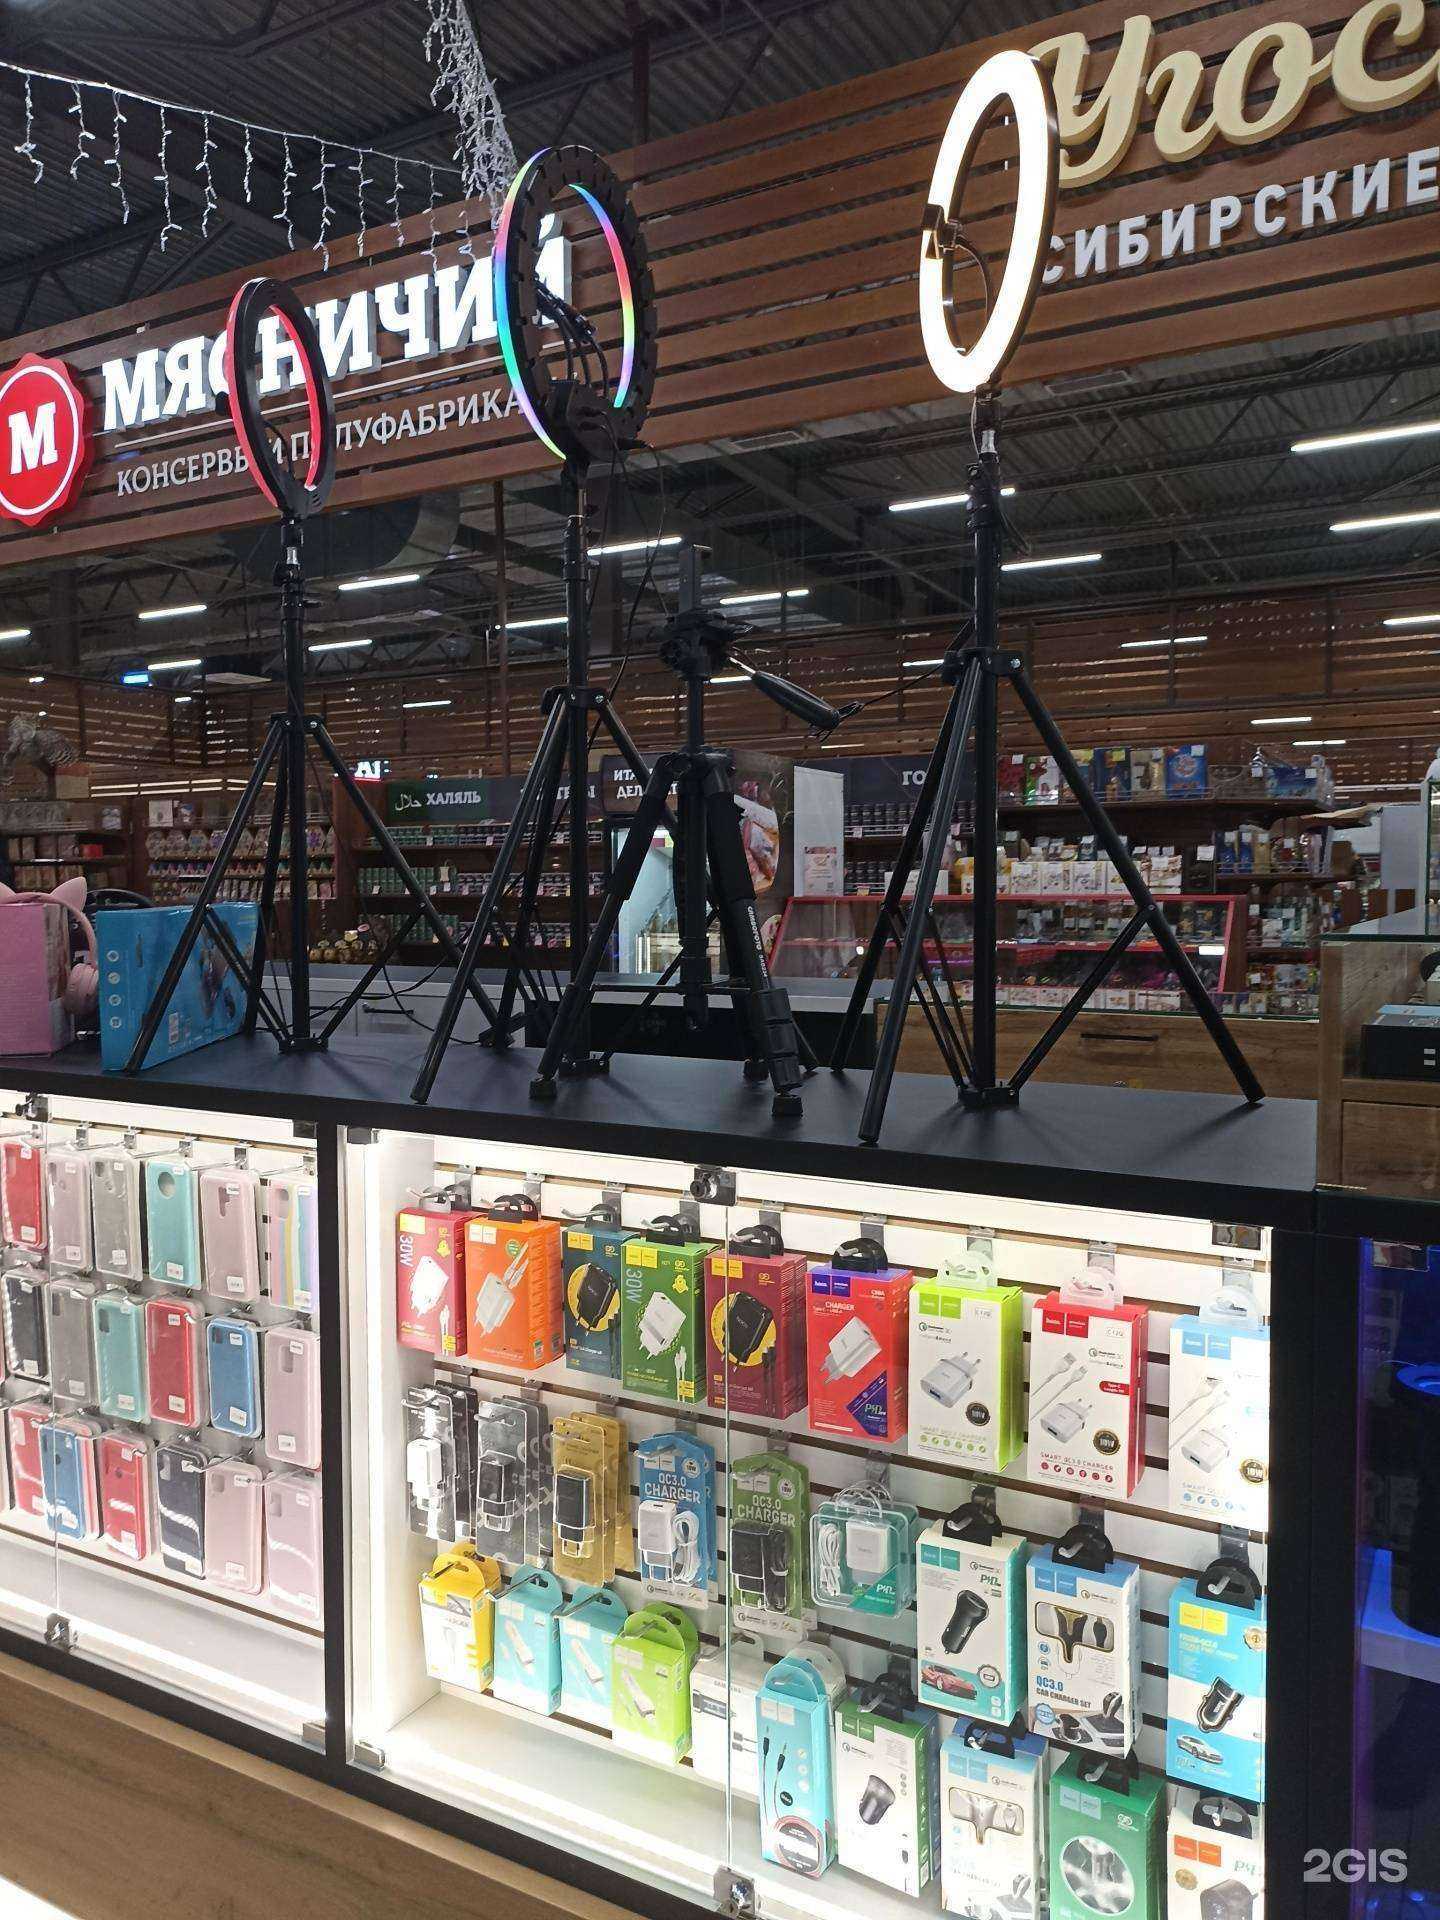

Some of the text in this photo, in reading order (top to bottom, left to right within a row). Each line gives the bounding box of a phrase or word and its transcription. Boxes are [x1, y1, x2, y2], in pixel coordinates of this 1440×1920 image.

[1028, 0, 1440, 188] Угос
[1041, 145, 1440, 285] СИБИРСКИЕ
[291, 387, 525, 462] ПЛУФАБРИКА
[8, 401, 58, 475] М
[426, 791, 481, 806] ХАЛЯЛЬ
[625, 1268, 643, 1304] 30W
[825, 1301, 855, 1311] CHARGER
[658, 1472, 687, 1488] QC3.0
[644, 1482, 701, 1504] CHARGER
[752, 1494, 782, 1511] QC3.0
[737, 1503, 796, 1528] CHARGER
[1036, 1675, 1064, 1692] QC3.0
[1036, 1687, 1049, 1697] CAR
